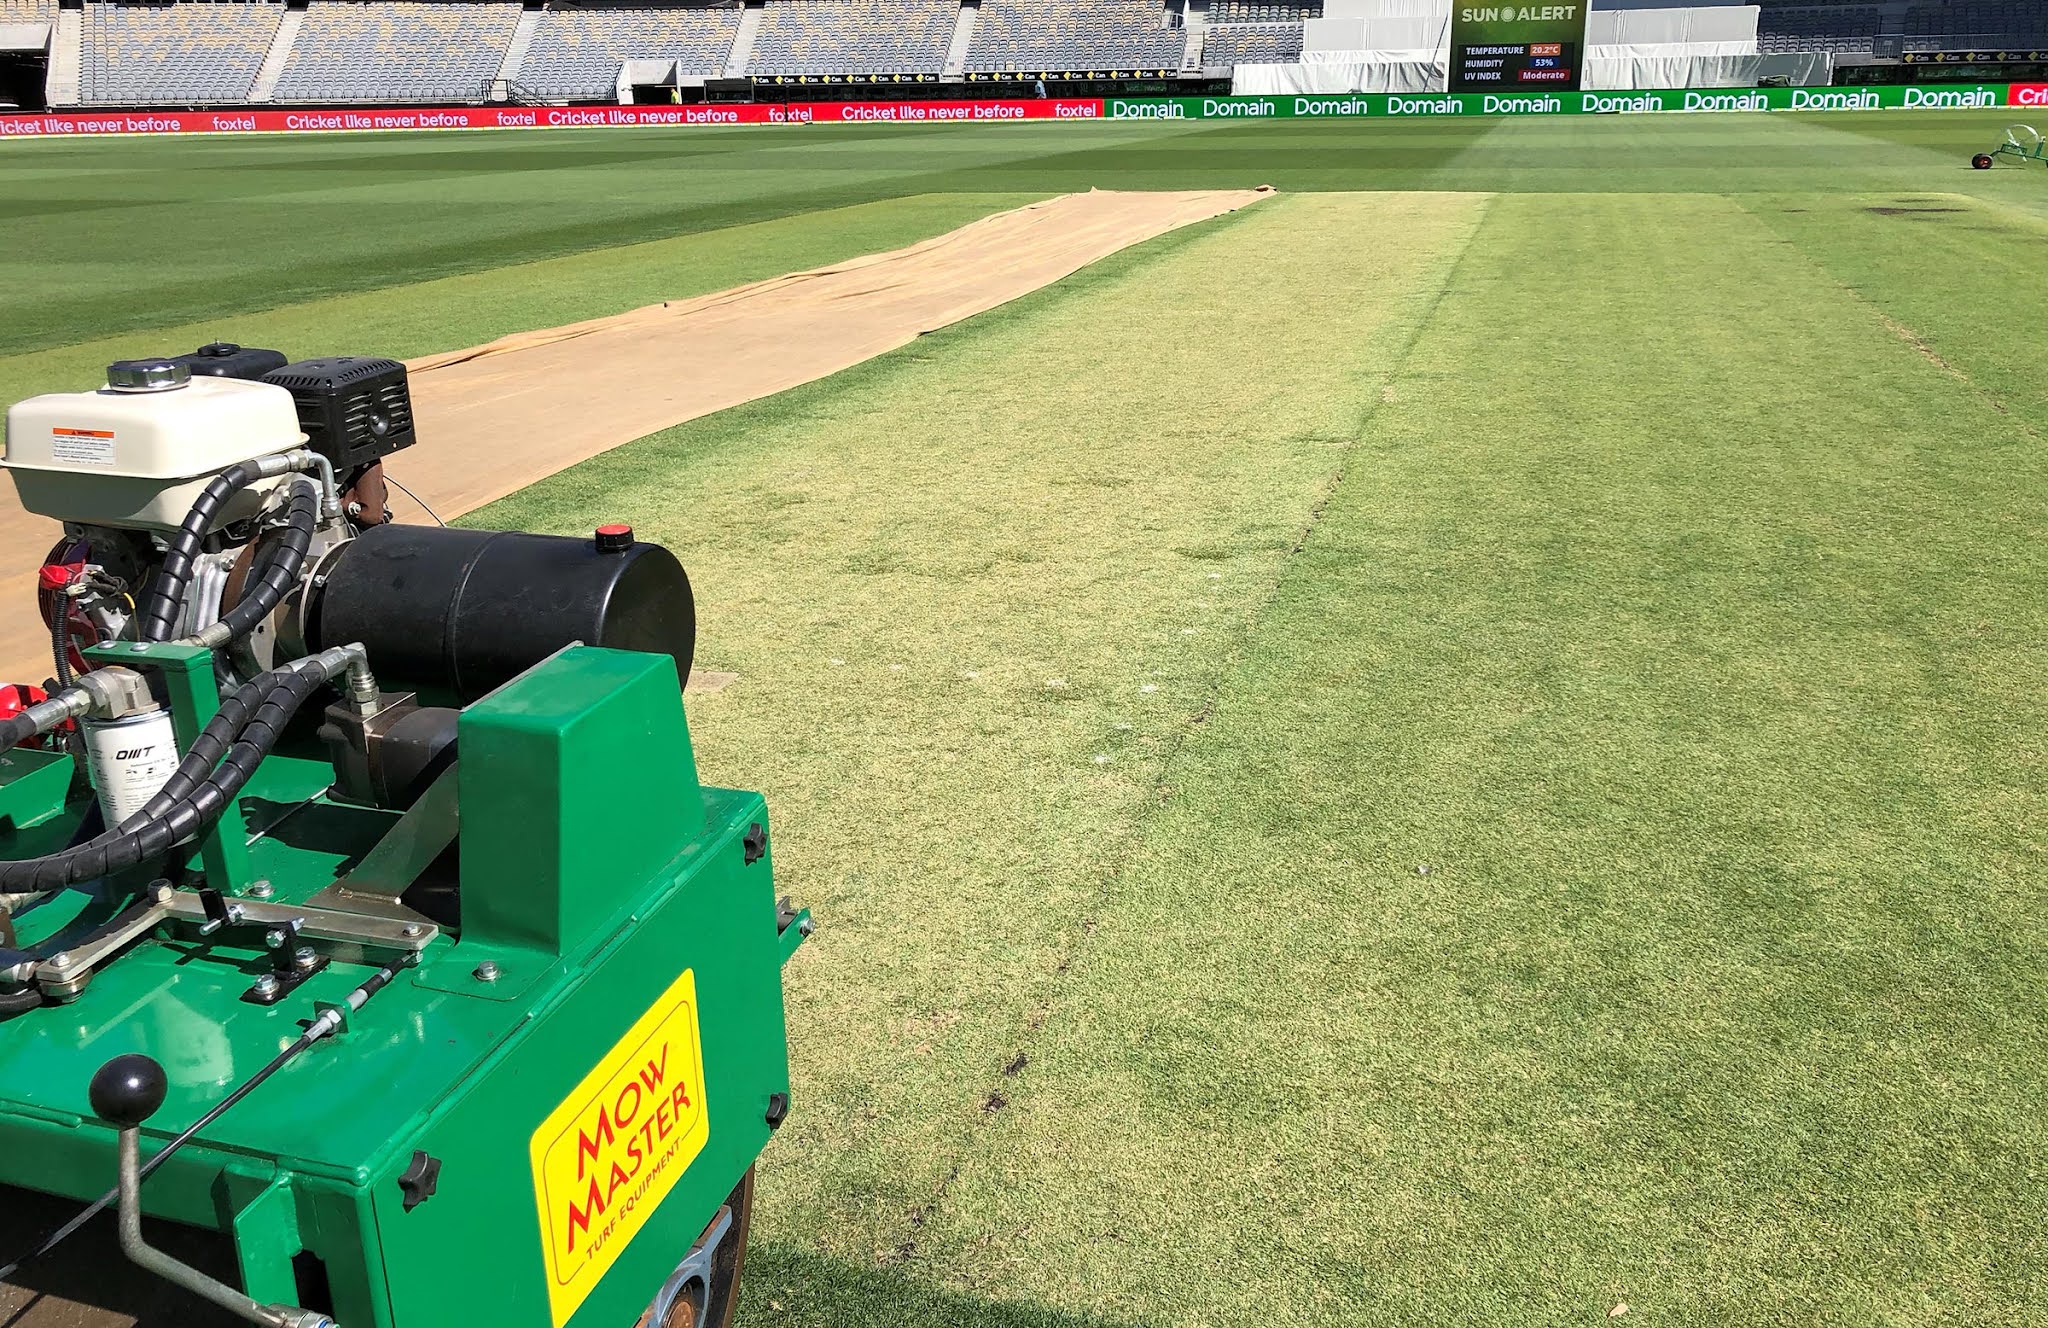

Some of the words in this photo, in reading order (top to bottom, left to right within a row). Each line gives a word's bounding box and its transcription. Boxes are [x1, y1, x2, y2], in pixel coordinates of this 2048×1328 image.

[1462, 8, 1499, 22] SUN
[1517, 5, 1576, 20] ALERT
[1466, 46, 1524, 55] TEMPERATURE
[1465, 59, 1504, 68] HUMIDITY
[1535, 58, 1554, 67] 53%
[1464, 72, 1476, 80] UV
[1477, 71, 1501, 80] INDEX
[1523, 71, 1565, 79] Moderate
[1483, 94, 1561, 113] Domain
[1582, 93, 1664, 112] Domain
[1683, 90, 1769, 110] Domain
[1791, 89, 1880, 109] Domain
[1904, 86, 1996, 107] Domain
[841, 106, 896, 121] Cricket
[899, 106, 926, 120] like
[928, 108, 973, 119] never
[974, 104, 1024, 119] before
[1054, 103, 1097, 118] foxtel
[1113, 99, 1184, 118] Domain
[1203, 98, 1275, 117] Domain
[1294, 97, 1368, 115] Domain
[1387, 96, 1463, 115] Domain
[286, 115, 342, 130] Cricket
[344, 114, 371, 129] like
[374, 116, 417, 129] never
[419, 113, 468, 128] before
[497, 112, 536, 126] foxtel
[548, 111, 604, 125] Cricket
[608, 110, 637, 124] like
[639, 112, 683, 124] never
[687, 109, 738, 123] before
[768, 107, 812, 122] foxtel
[44, 118, 73, 133] like
[76, 120, 123, 133] never
[126, 118, 181, 132] before
[212, 116, 256, 131] foxtel
[578, 1041, 669, 1183] MOW
[567, 1081, 691, 1254] MASTER
[586, 1220, 616, 1260] TURF
[620, 1136, 682, 1221] EQUIPMENT
